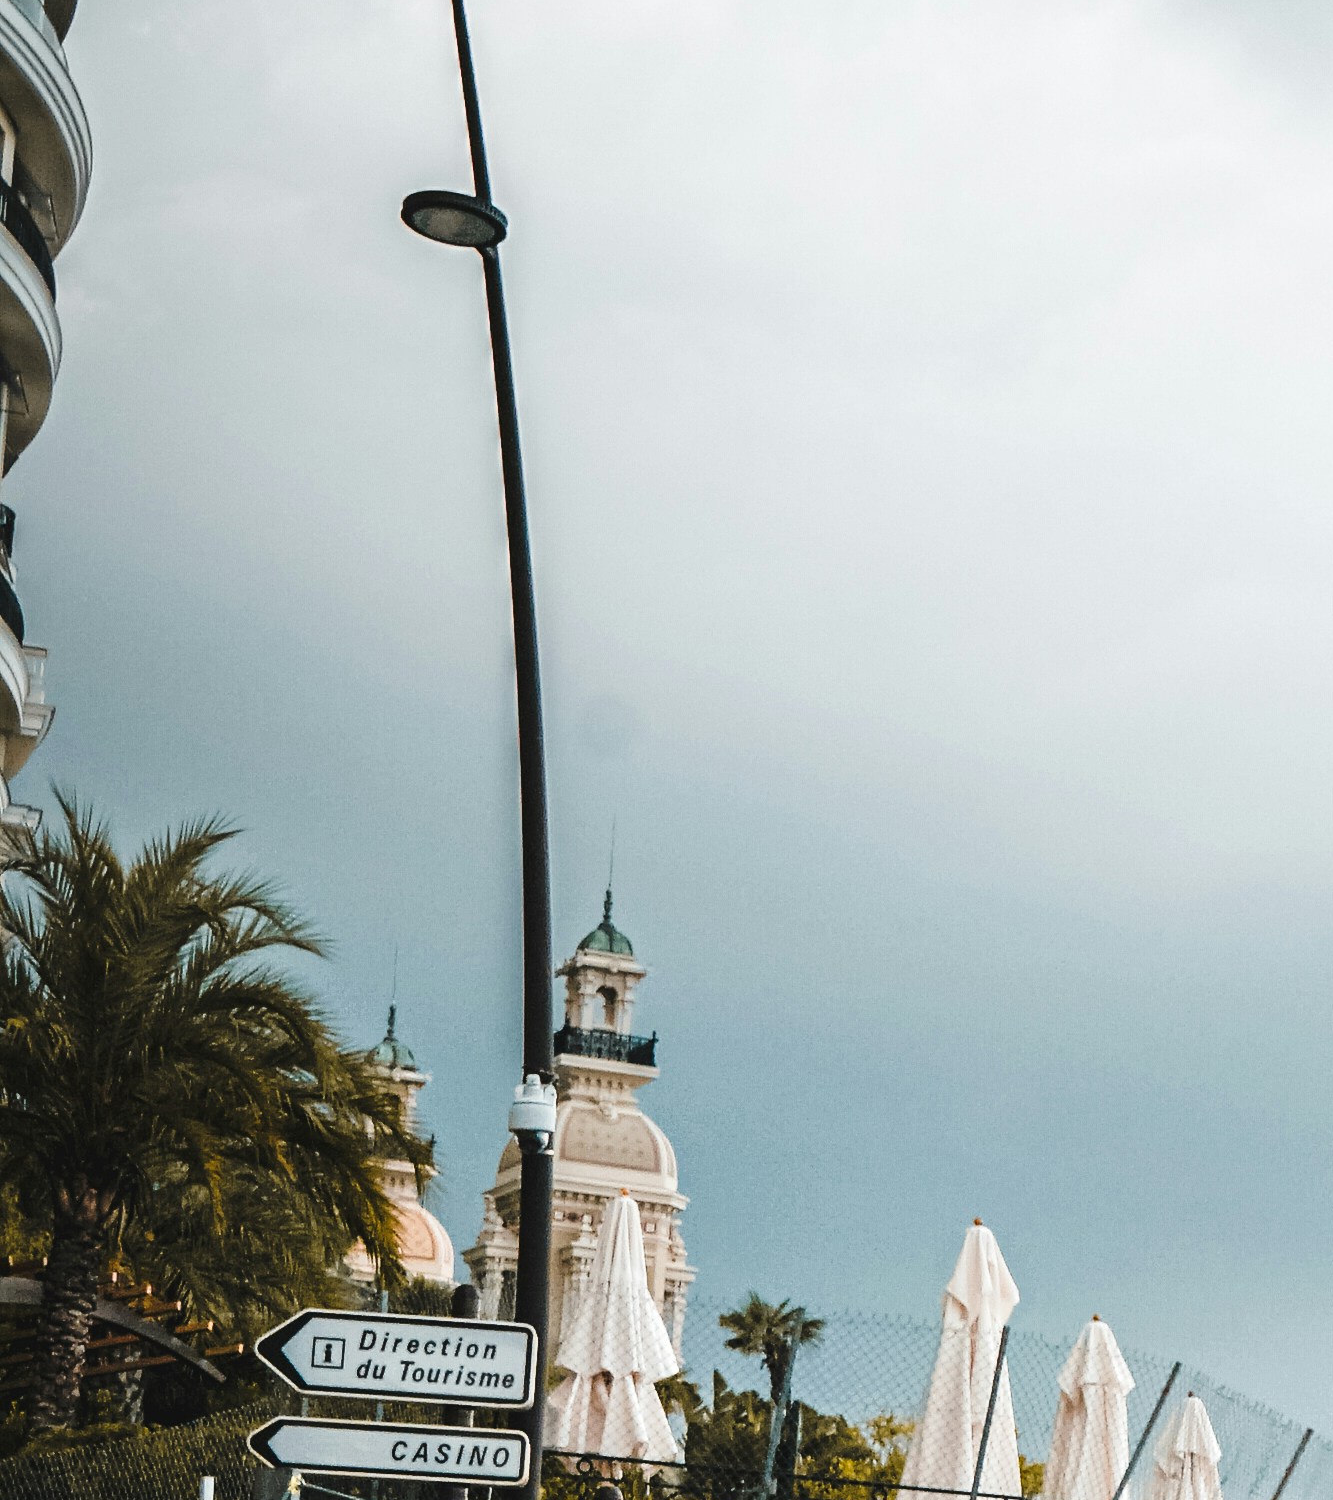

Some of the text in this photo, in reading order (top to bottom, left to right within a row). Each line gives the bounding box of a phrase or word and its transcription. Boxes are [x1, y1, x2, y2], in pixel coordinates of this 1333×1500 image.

[359, 1329, 497, 1360] Direction
[356, 1359, 515, 1388] du Tourisme
[391, 1440, 510, 1467] CASINO
